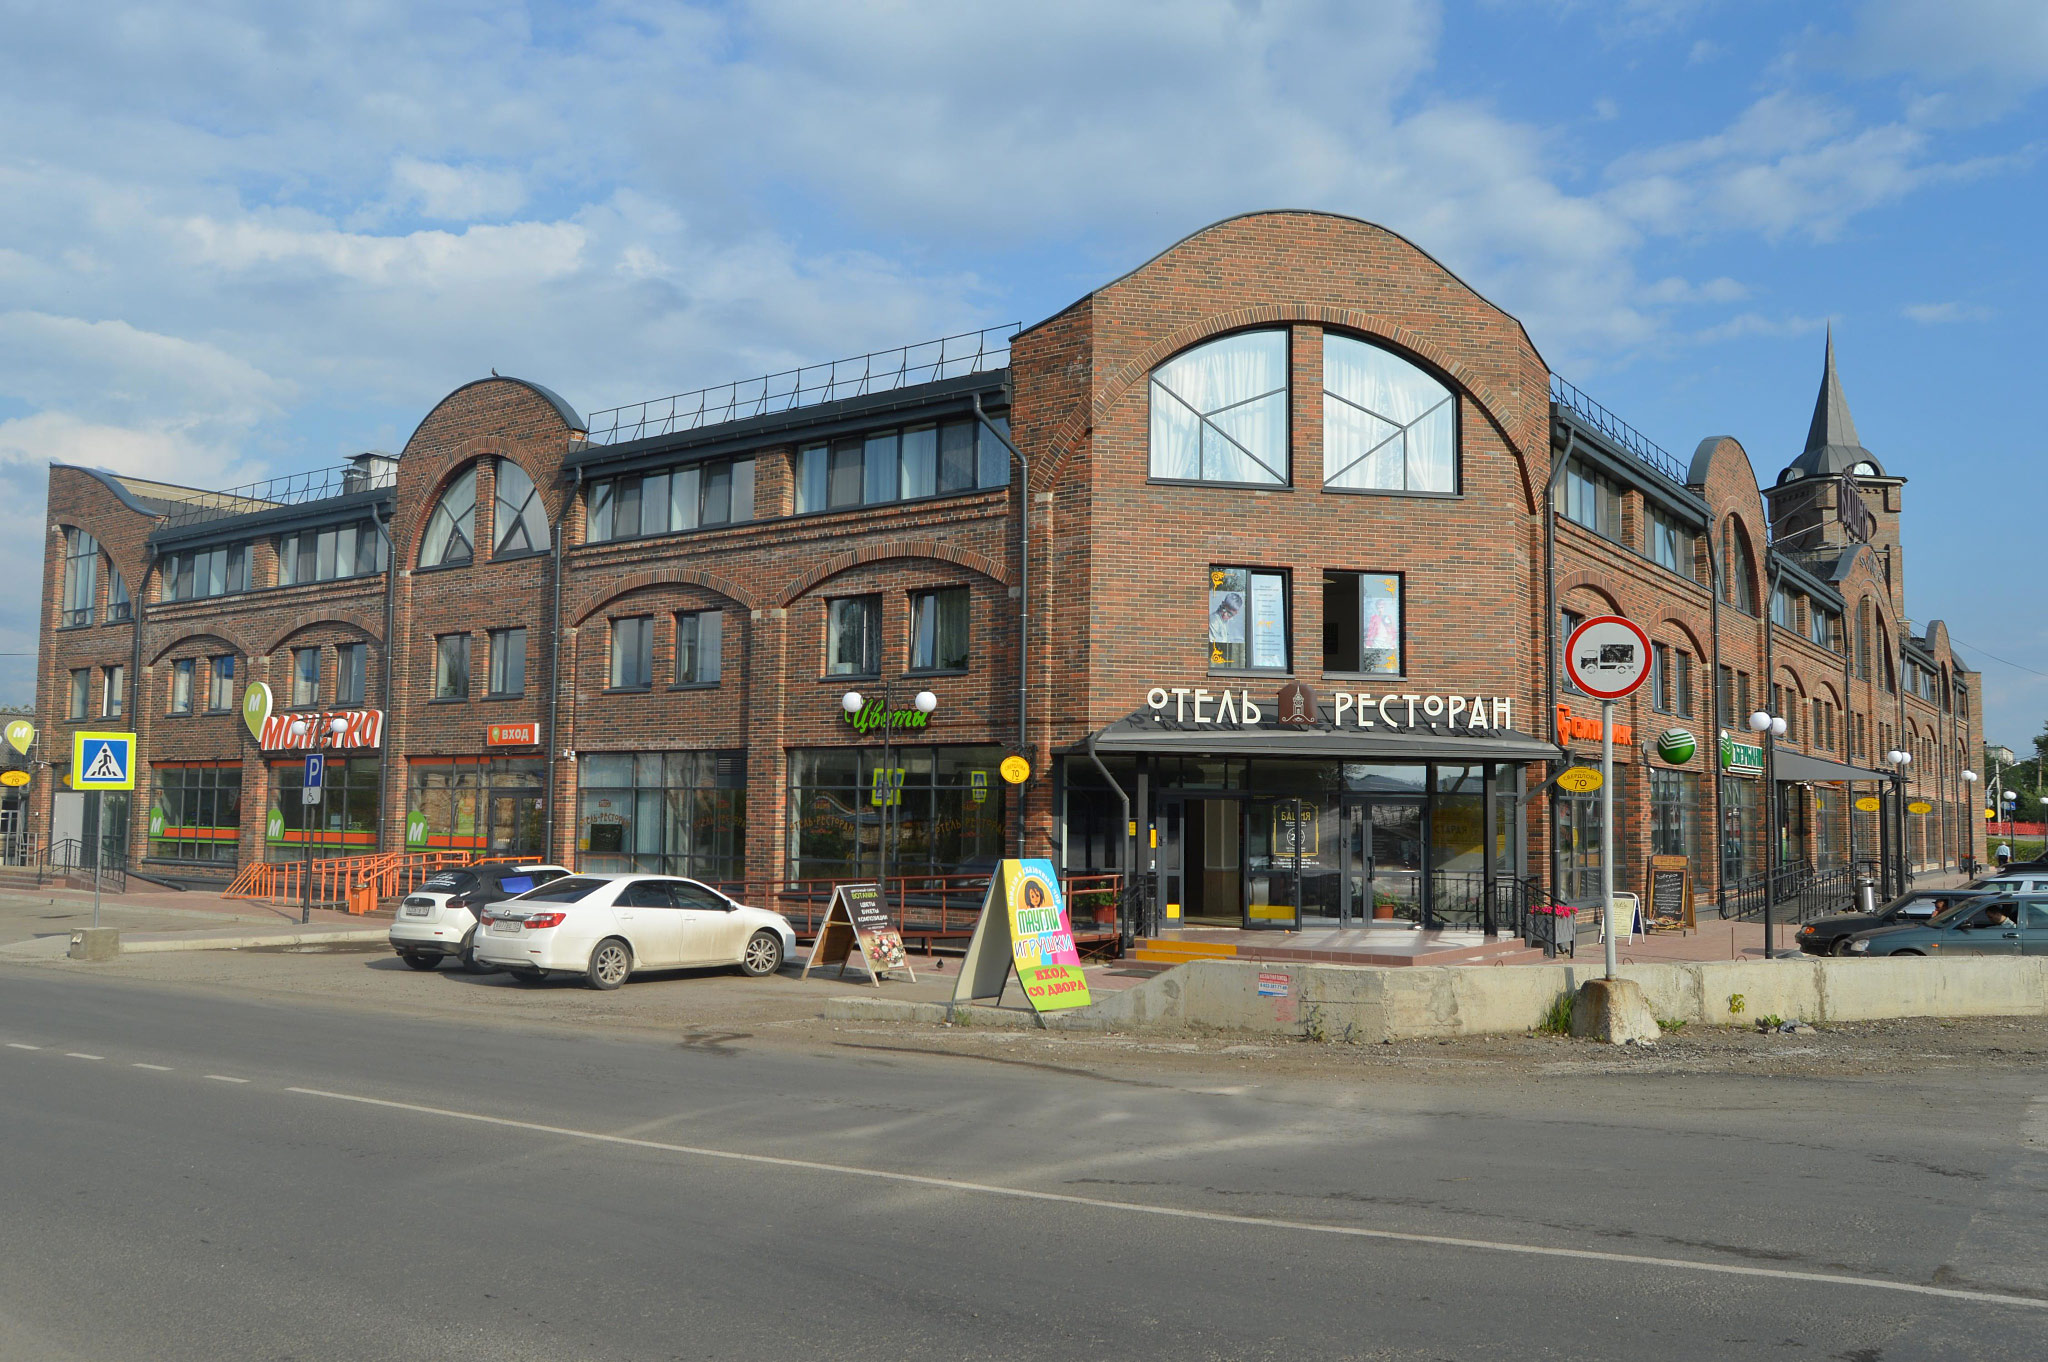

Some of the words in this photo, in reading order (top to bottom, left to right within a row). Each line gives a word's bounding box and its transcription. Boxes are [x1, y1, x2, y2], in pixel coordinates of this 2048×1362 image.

[844, 698, 928, 734] Цветы
[1147, 687, 1262, 724] ОТЕЛЬ
[1335, 692, 1511, 730] РЕСТОРАН
[502, 728, 529, 742] ВХОД
[1563, 773, 1598, 781] СВЕРДЛОВА
[1574, 779, 1588, 790] 70
[1281, 811, 1311, 821] БАНЯ
[1017, 908, 1060, 934] МАУГЛИ
[1014, 934, 1074, 958] ИГРУШКИ
[1034, 966, 1070, 981] ВХОД
[1028, 985, 1045, 997] СО
[1047, 980, 1086, 997] ДВОРА
